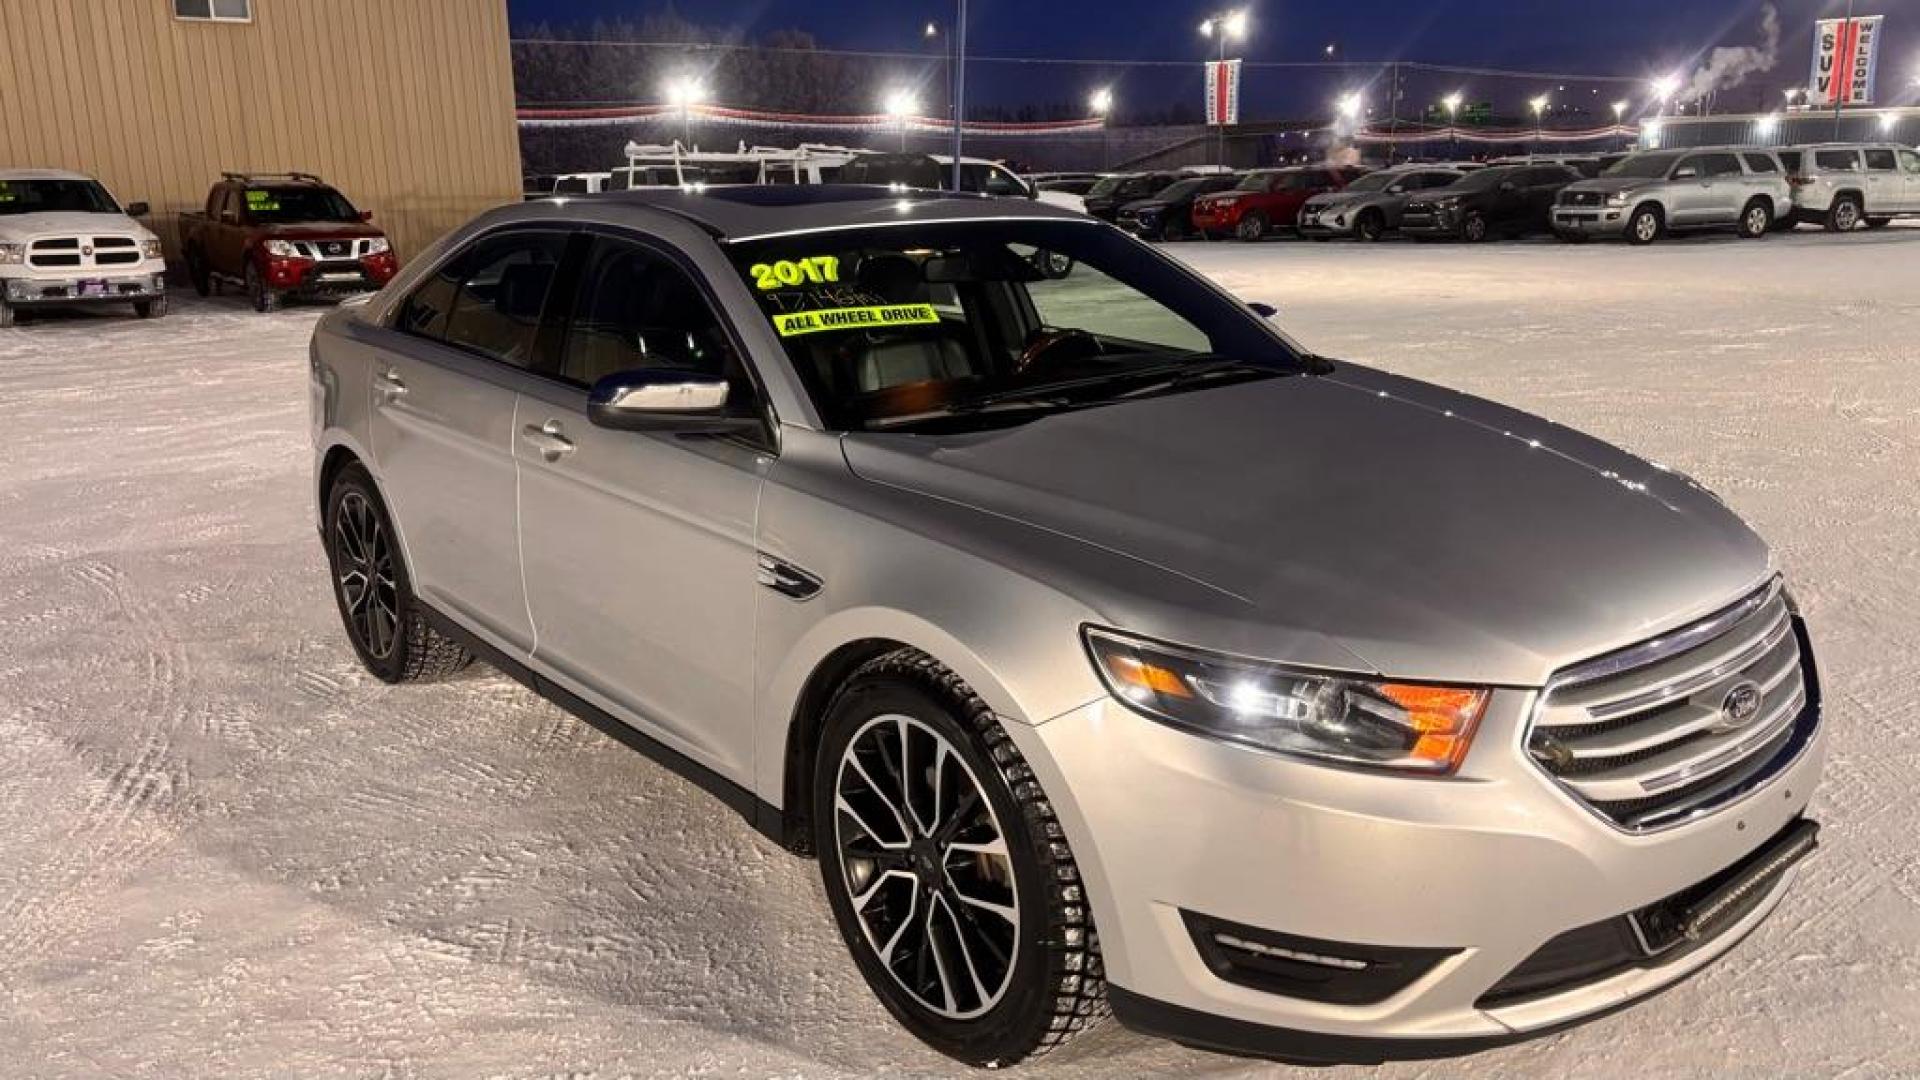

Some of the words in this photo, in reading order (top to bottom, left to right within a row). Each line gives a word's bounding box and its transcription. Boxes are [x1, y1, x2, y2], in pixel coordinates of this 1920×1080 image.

[1818, 33, 1835, 93] SUV
[1853, 22, 1873, 100] WELCOME
[750, 255, 839, 290] 2017
[784, 316, 816, 331] ALL
[819, 309, 879, 326] WHEEL
[880, 306, 930, 322] DRIVE
